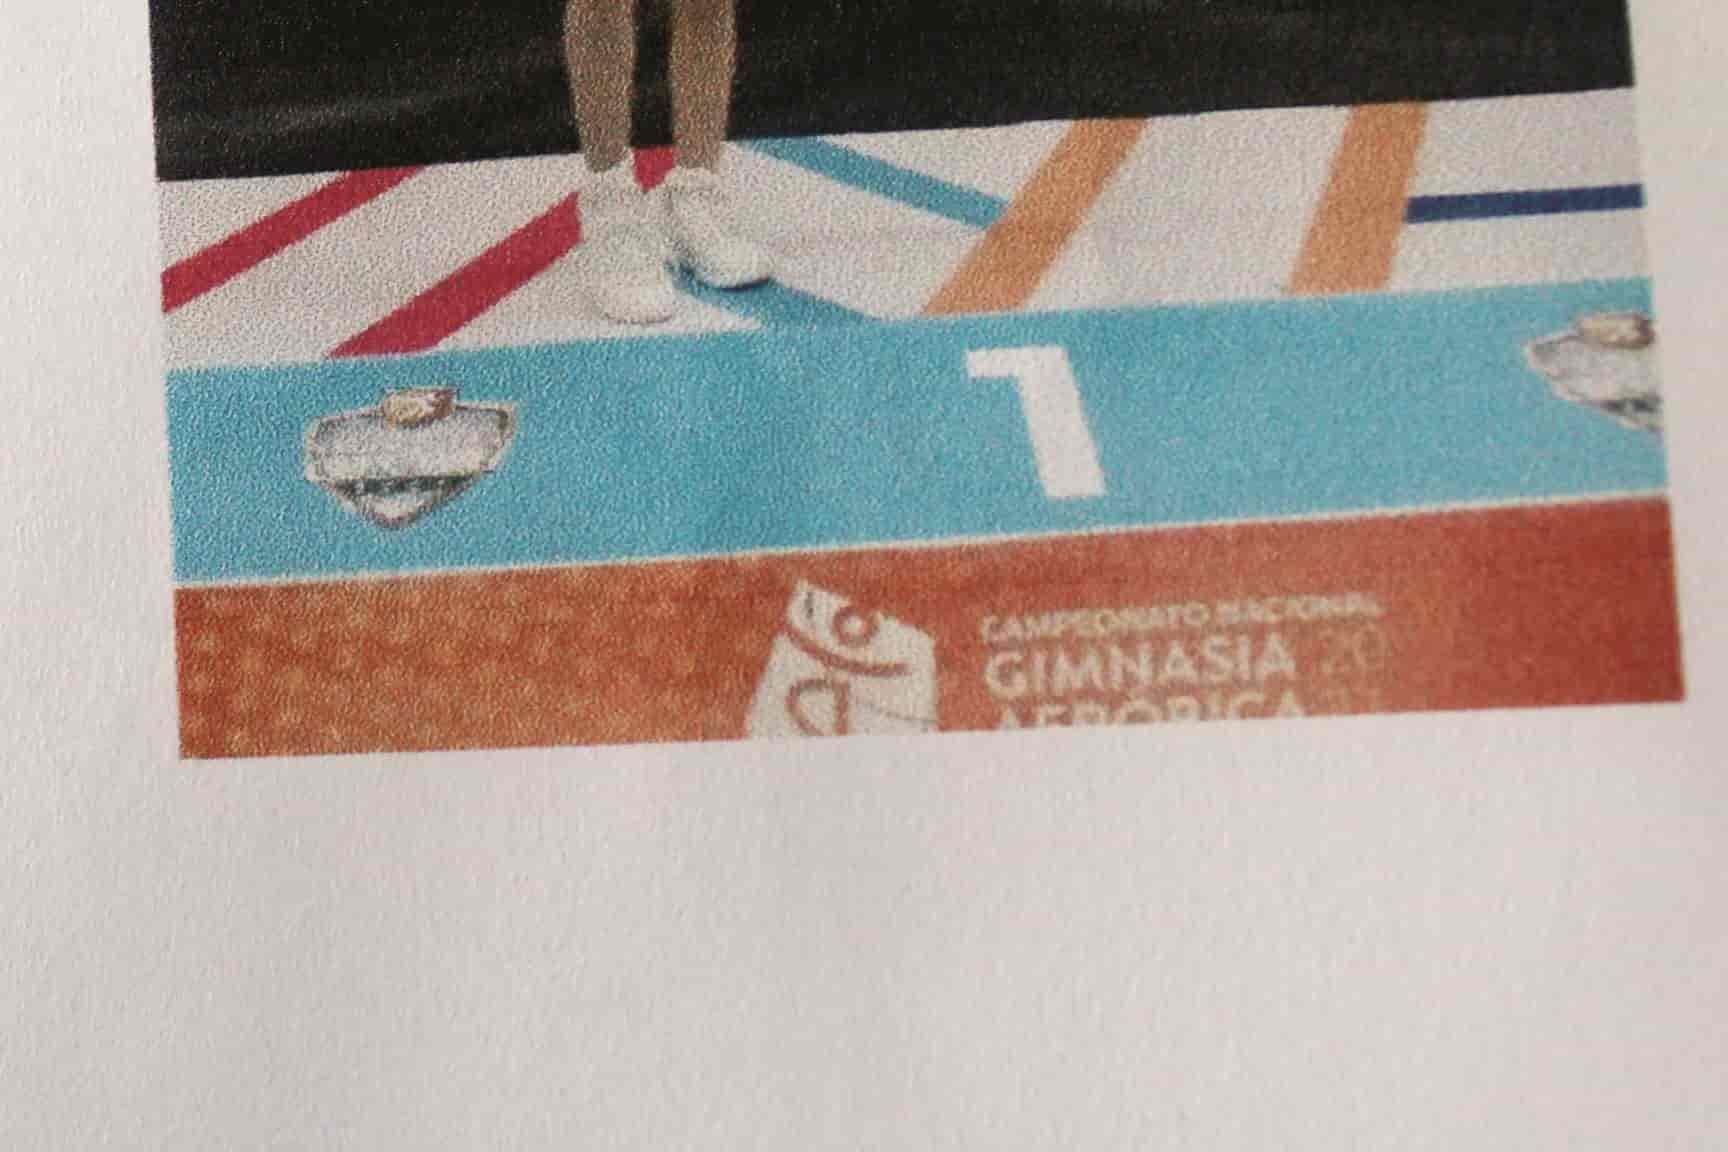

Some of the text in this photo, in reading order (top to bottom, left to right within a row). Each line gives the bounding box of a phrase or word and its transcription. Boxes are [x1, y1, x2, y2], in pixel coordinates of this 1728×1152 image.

[965, 346, 1108, 500] 1
[980, 590, 1385, 645] CAMPEONATO NACIONAL
[983, 631, 1296, 701] GIMNASIA
